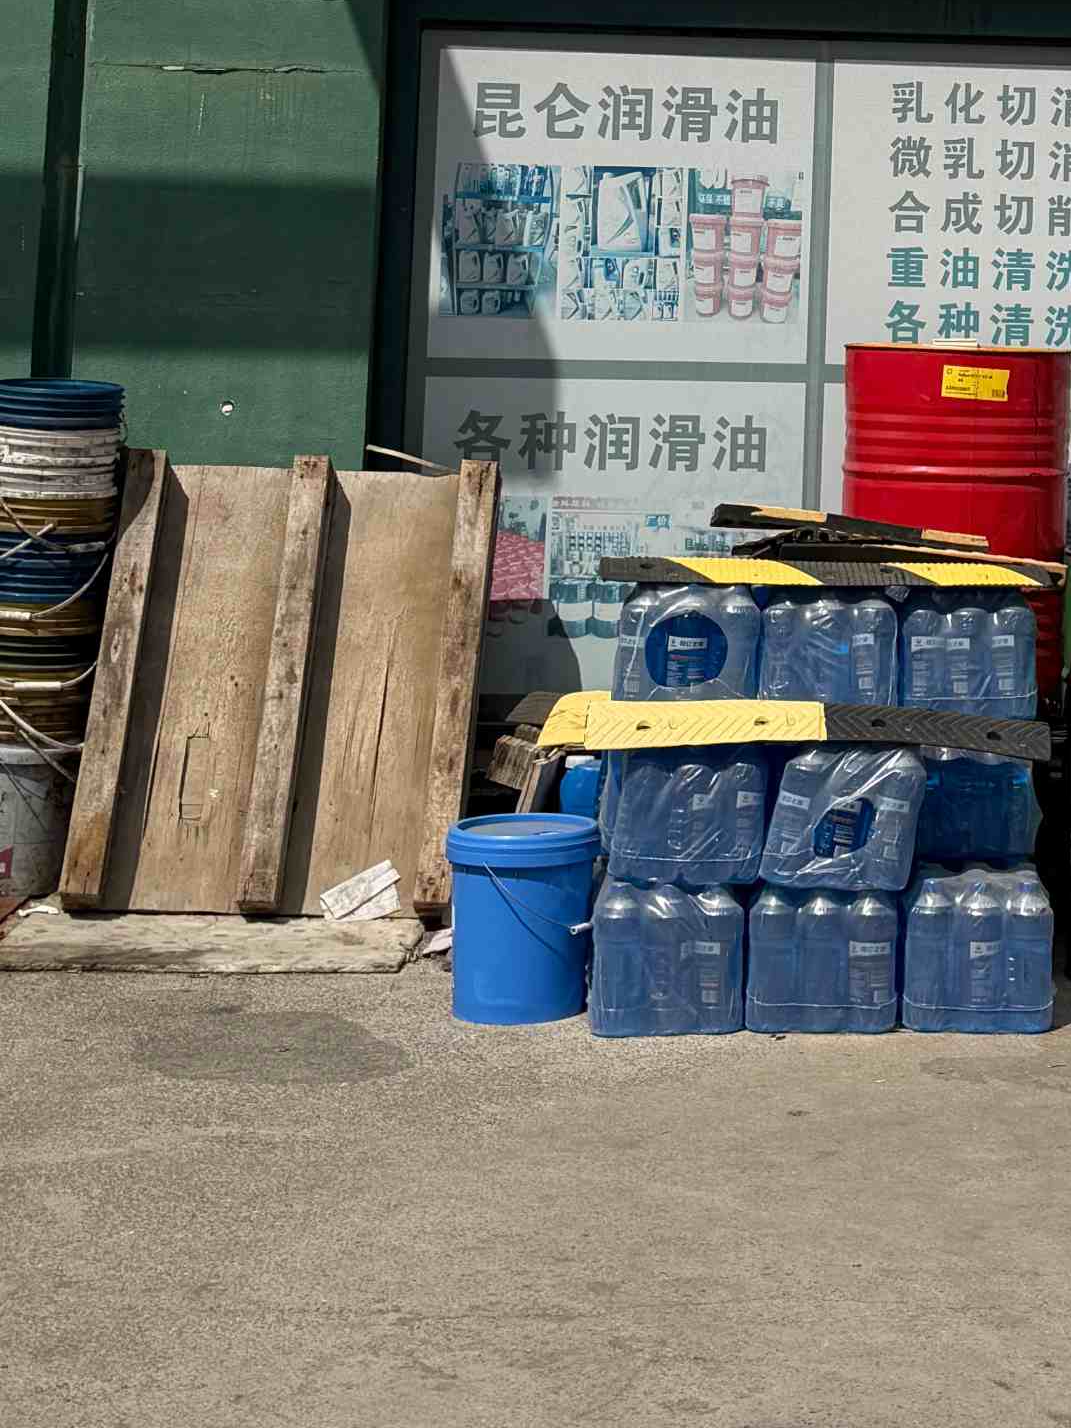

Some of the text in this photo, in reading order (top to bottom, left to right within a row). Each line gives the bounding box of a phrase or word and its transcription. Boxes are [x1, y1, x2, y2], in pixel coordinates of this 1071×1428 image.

[472, 82, 780, 145] 昆仑润滑油
[453, 410, 769, 473] 各种润滑油
